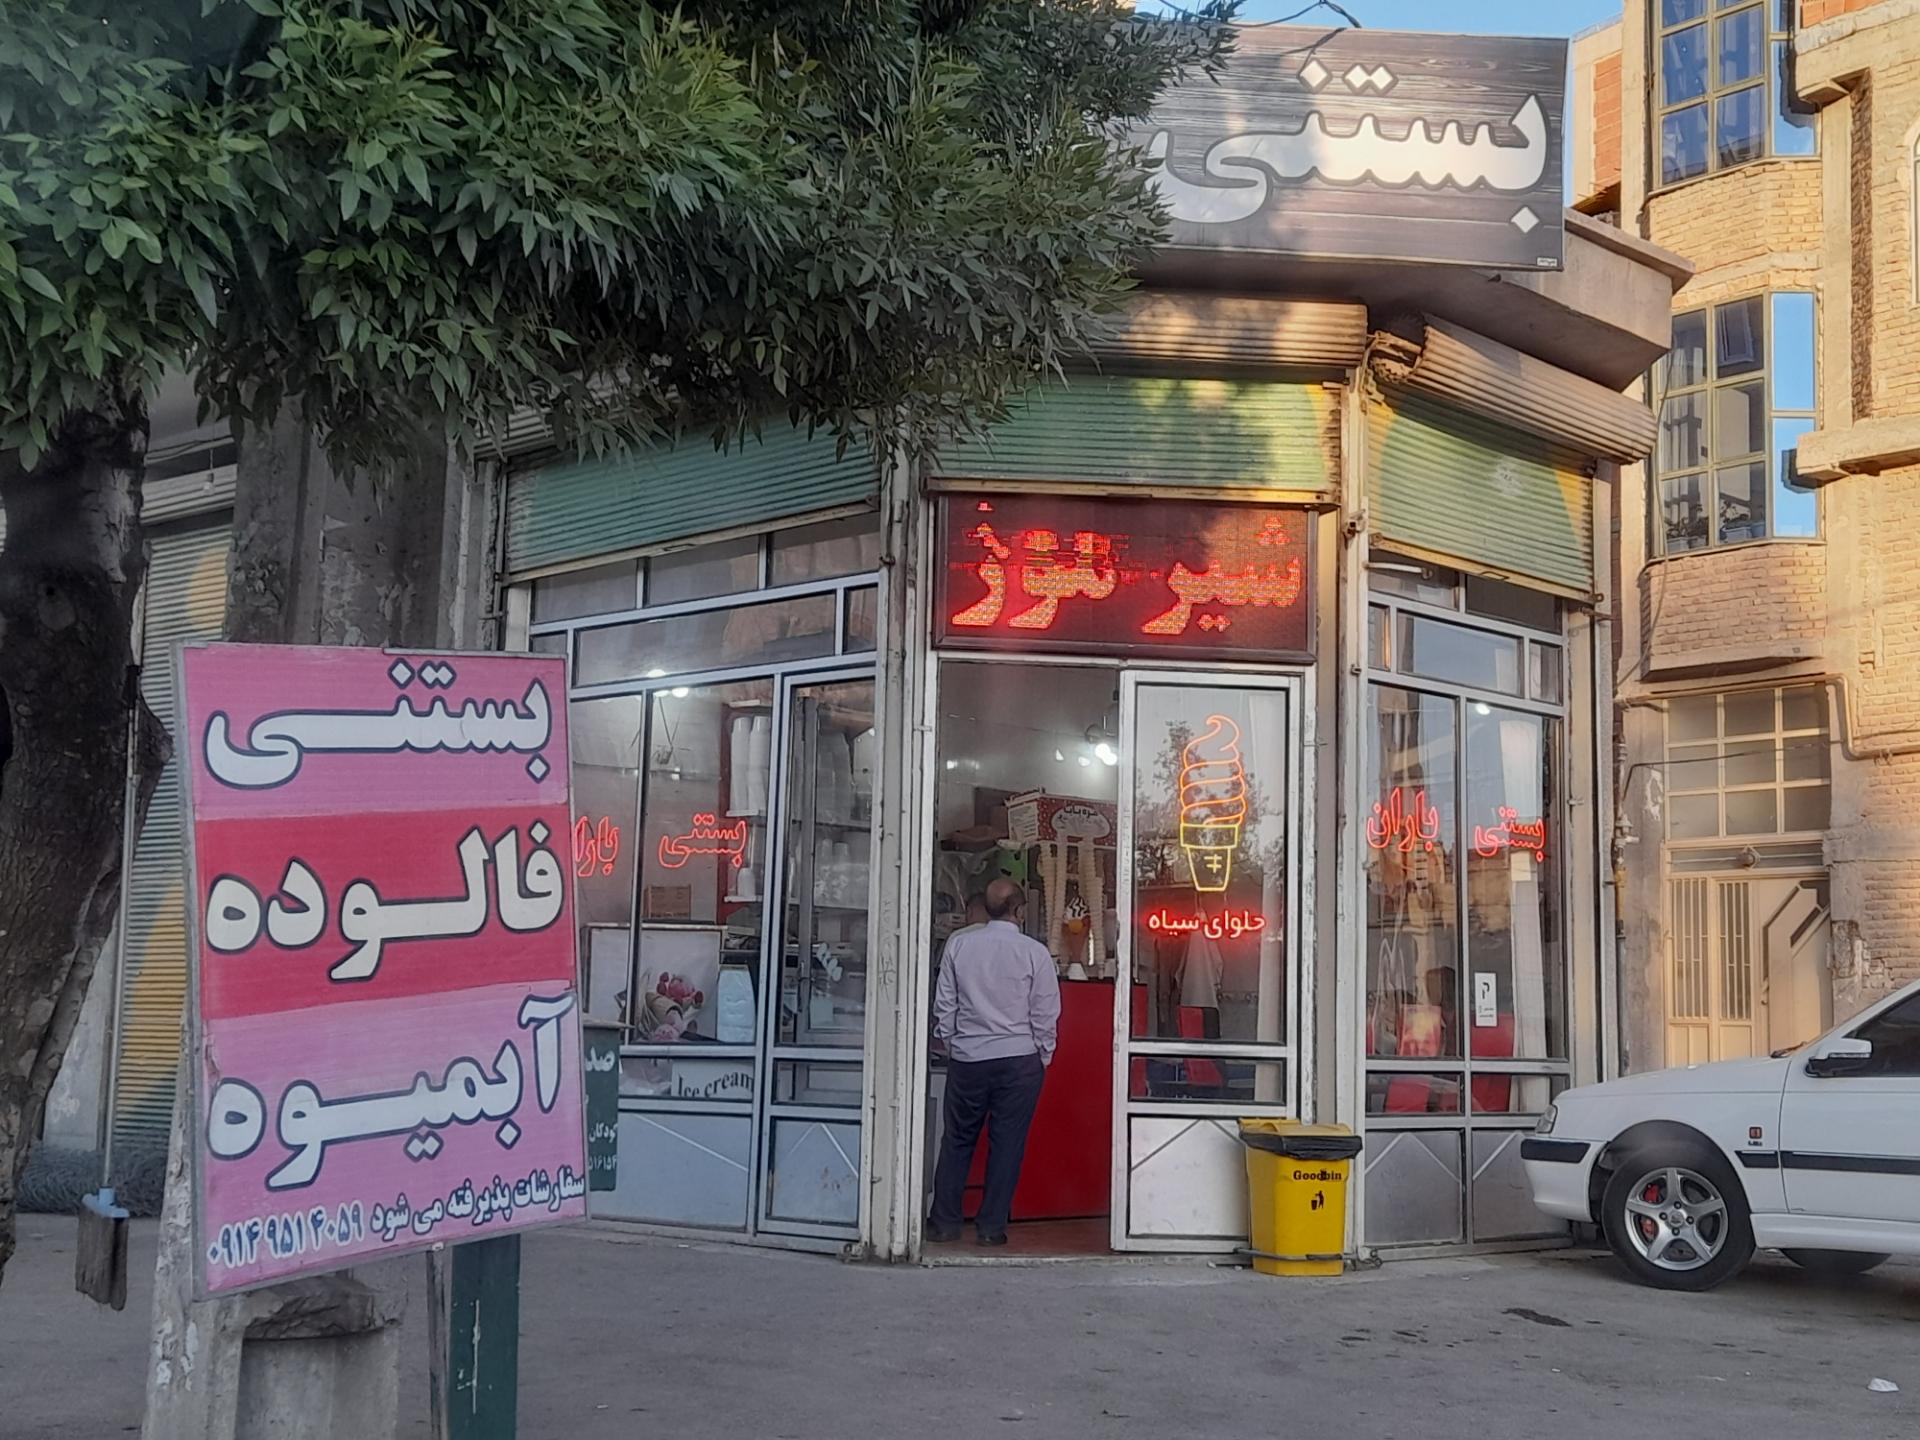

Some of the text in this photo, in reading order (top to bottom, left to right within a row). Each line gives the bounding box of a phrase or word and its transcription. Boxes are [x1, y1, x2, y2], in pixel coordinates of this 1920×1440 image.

[1144, 59, 1547, 234] بستنی
[203, 658, 552, 789] بستنی
[574, 813, 746, 877] بستنی بارا
[1366, 786, 1545, 863] بستنی باران
[204, 820, 565, 982] فالوده
[1148, 909, 1266, 939] حلوای سیاه
[207, 992, 577, 1190] آبمیوه
[704, 1071, 754, 1098] cream
[411, 1198, 445, 1234] می
[446, 1175, 512, 1226] پذیرفته
[512, 1164, 585, 1212] سفارشات
[370, 1193, 411, 1242] شود
